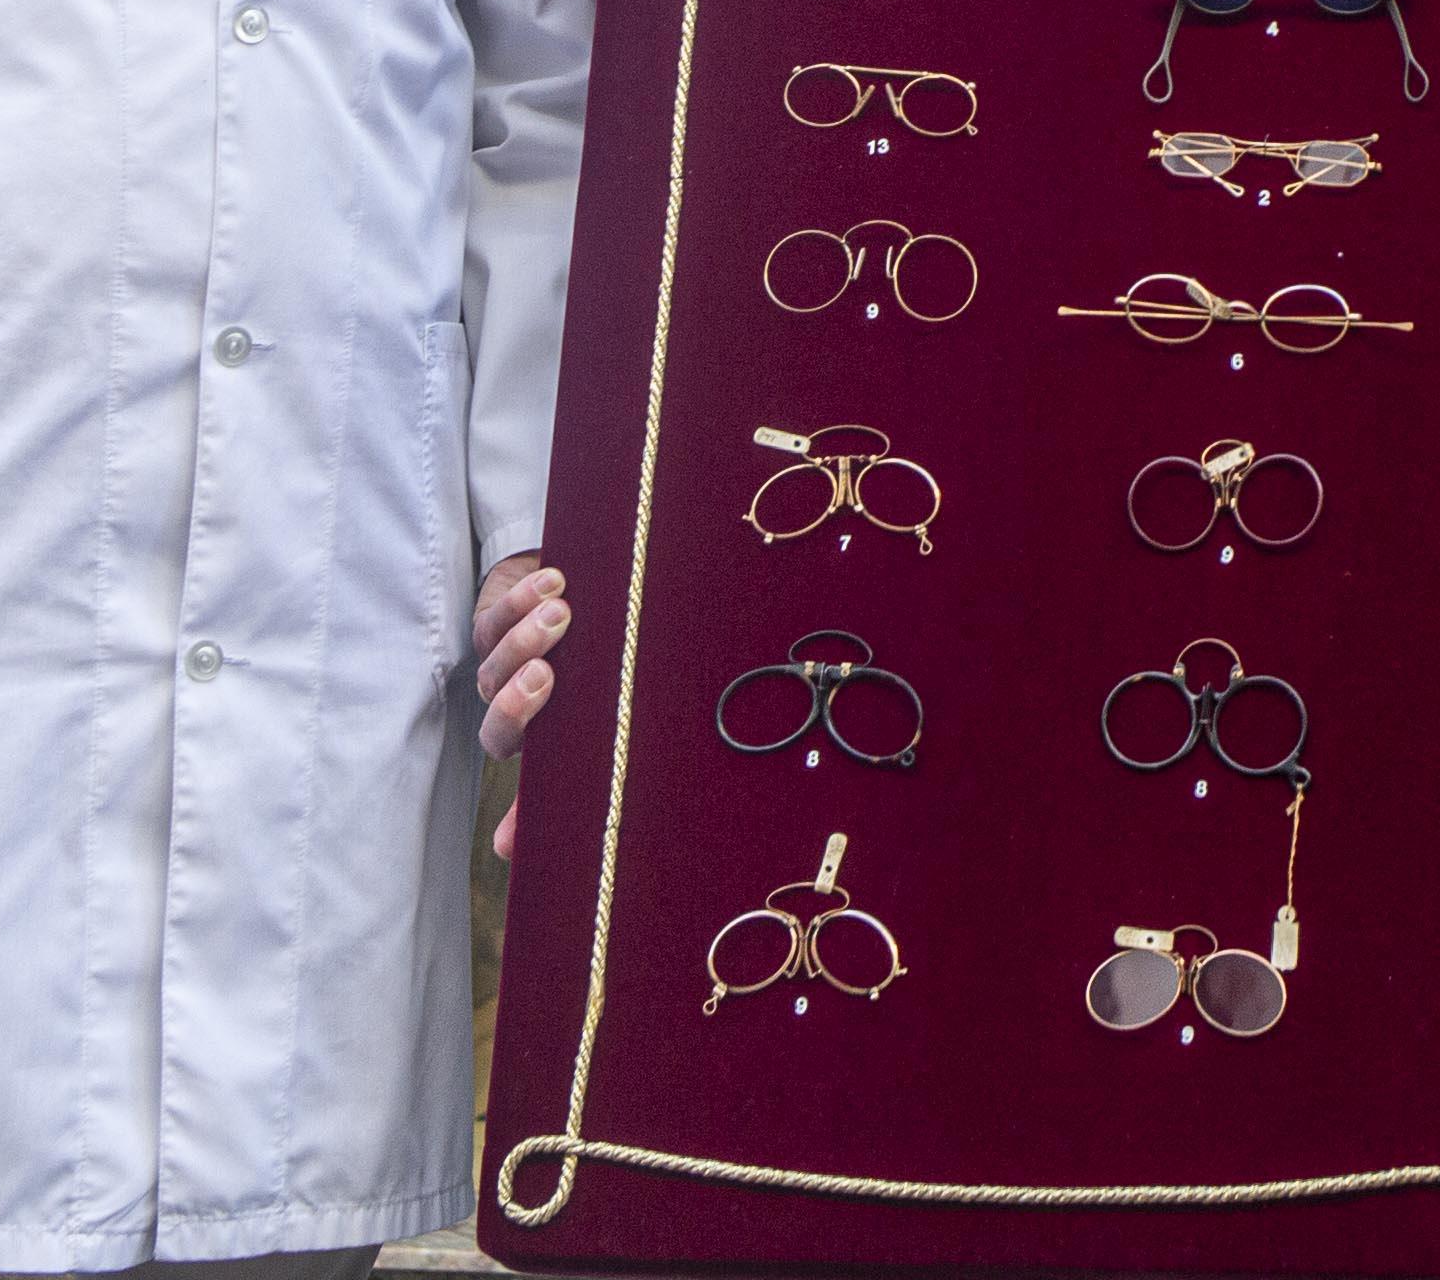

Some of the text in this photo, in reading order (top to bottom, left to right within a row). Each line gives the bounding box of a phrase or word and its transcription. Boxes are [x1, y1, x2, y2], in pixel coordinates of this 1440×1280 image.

[1265, 20, 1280, 37] 4
[866, 137, 890, 156] 13
[1258, 189, 1271, 207] 2
[865, 302, 880, 320] 9
[1230, 352, 1245, 371] 6
[839, 534, 852, 552] 7
[1220, 545, 1235, 564] 9
[805, 749, 820, 768] 8
[1194, 779, 1208, 798] 8
[794, 996, 809, 1016] 9
[1181, 1025, 1195, 1045] 9
